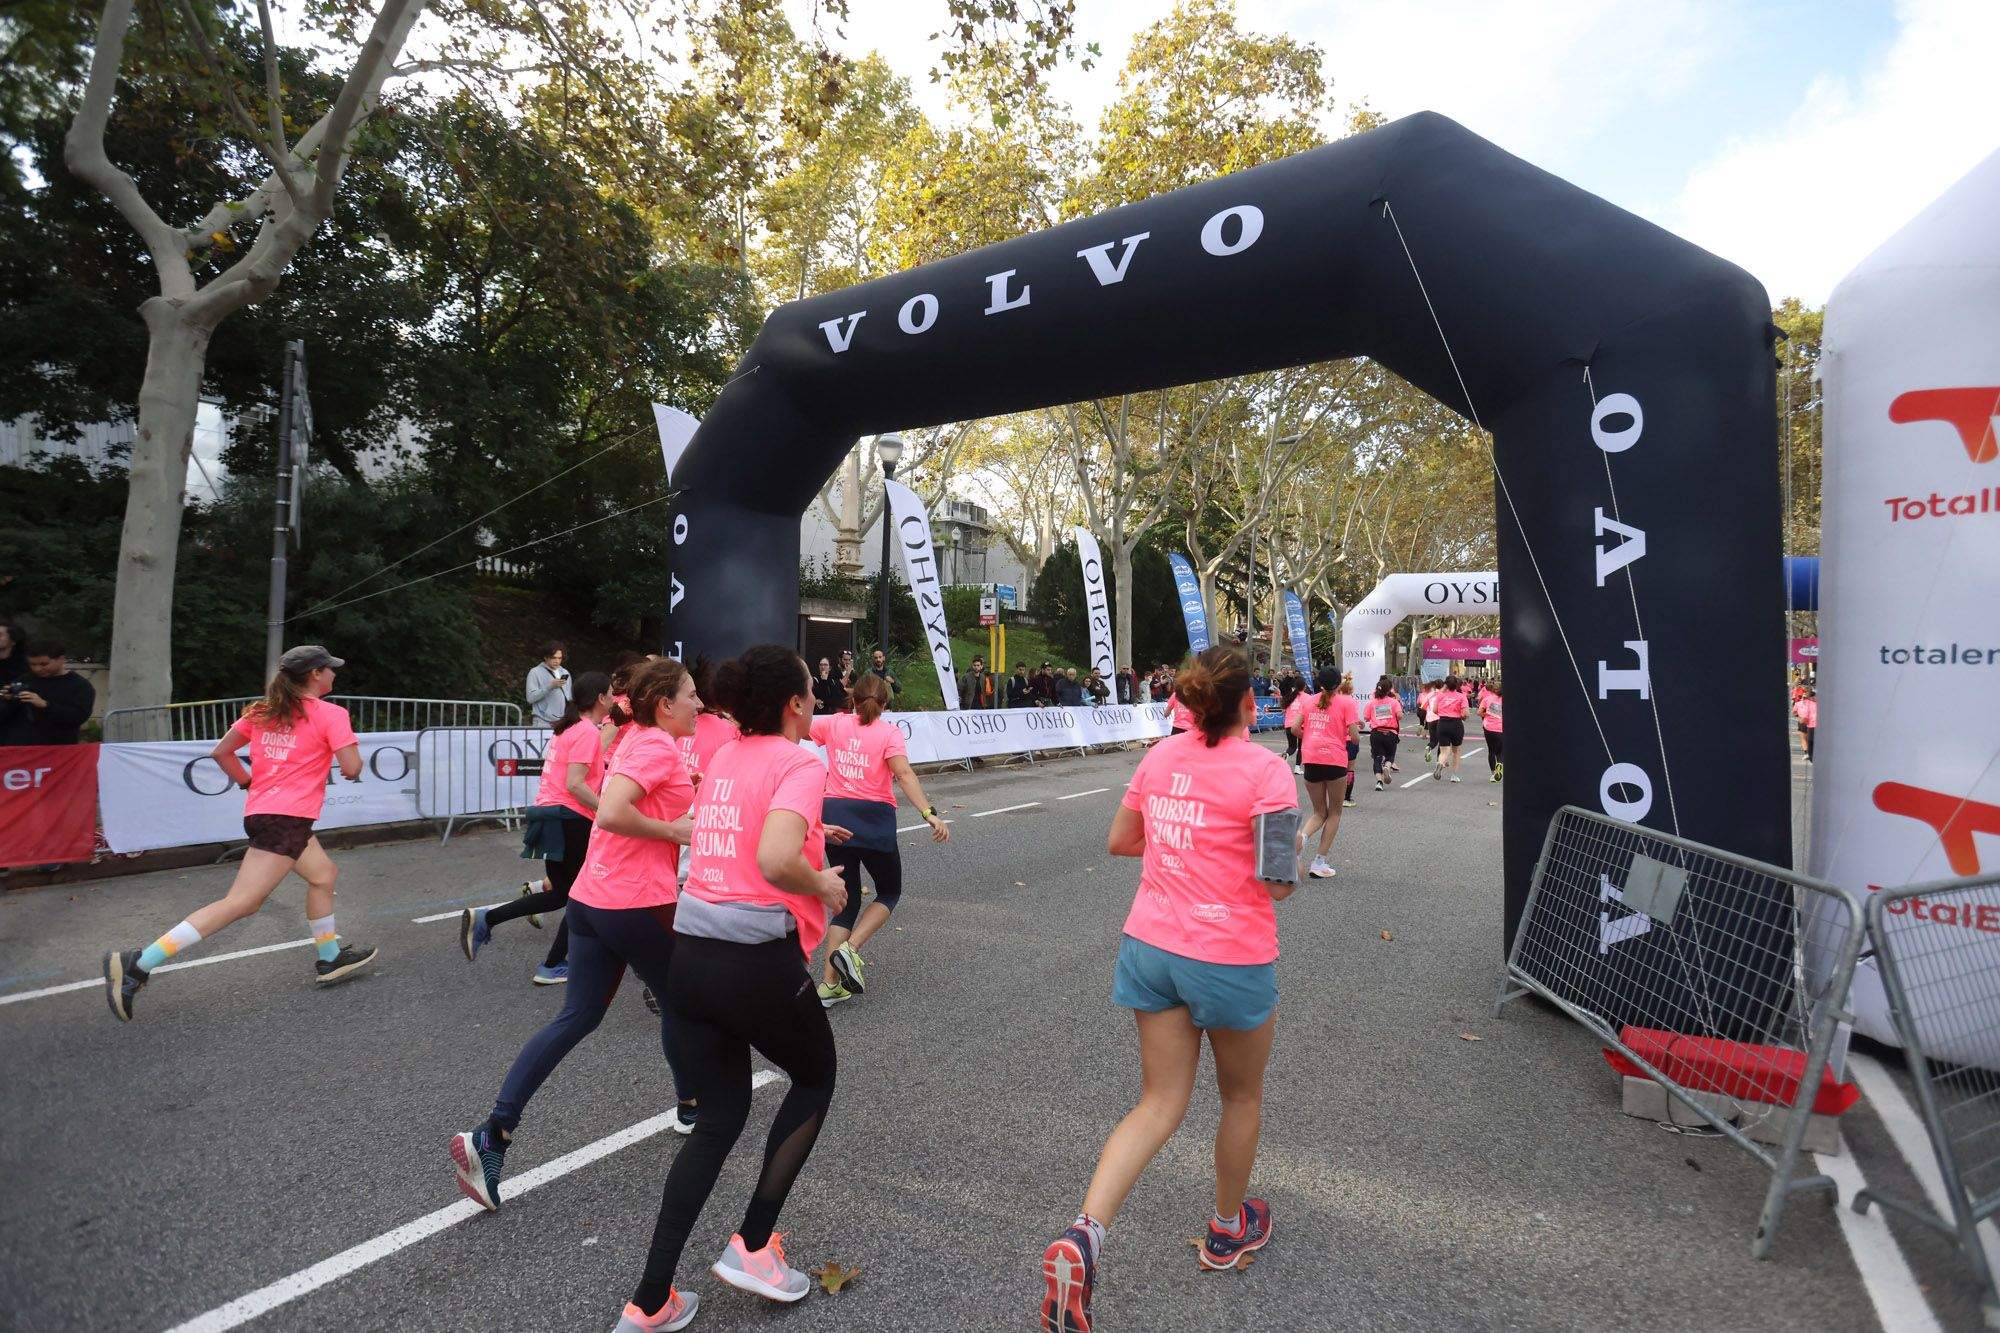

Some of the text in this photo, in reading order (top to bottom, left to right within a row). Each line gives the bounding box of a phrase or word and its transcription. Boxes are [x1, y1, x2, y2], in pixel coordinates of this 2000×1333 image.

[818, 204, 1265, 355] VOLVO
[1358, 607, 1392, 616] OYSHO
[1345, 650, 1374, 658] OYSHO
[947, 714, 1006, 736] OYSHO
[1026, 711, 1074, 730] OYSHO
[1092, 708, 1131, 728] OYSHO
[848, 738, 861, 751] TU
[712, 779, 734, 802] TU
[1171, 772, 1192, 796] TU
[1149, 795, 1207, 827] DORSAL
[697, 832, 736, 858] SUMA
[703, 868, 724, 882] 2024
